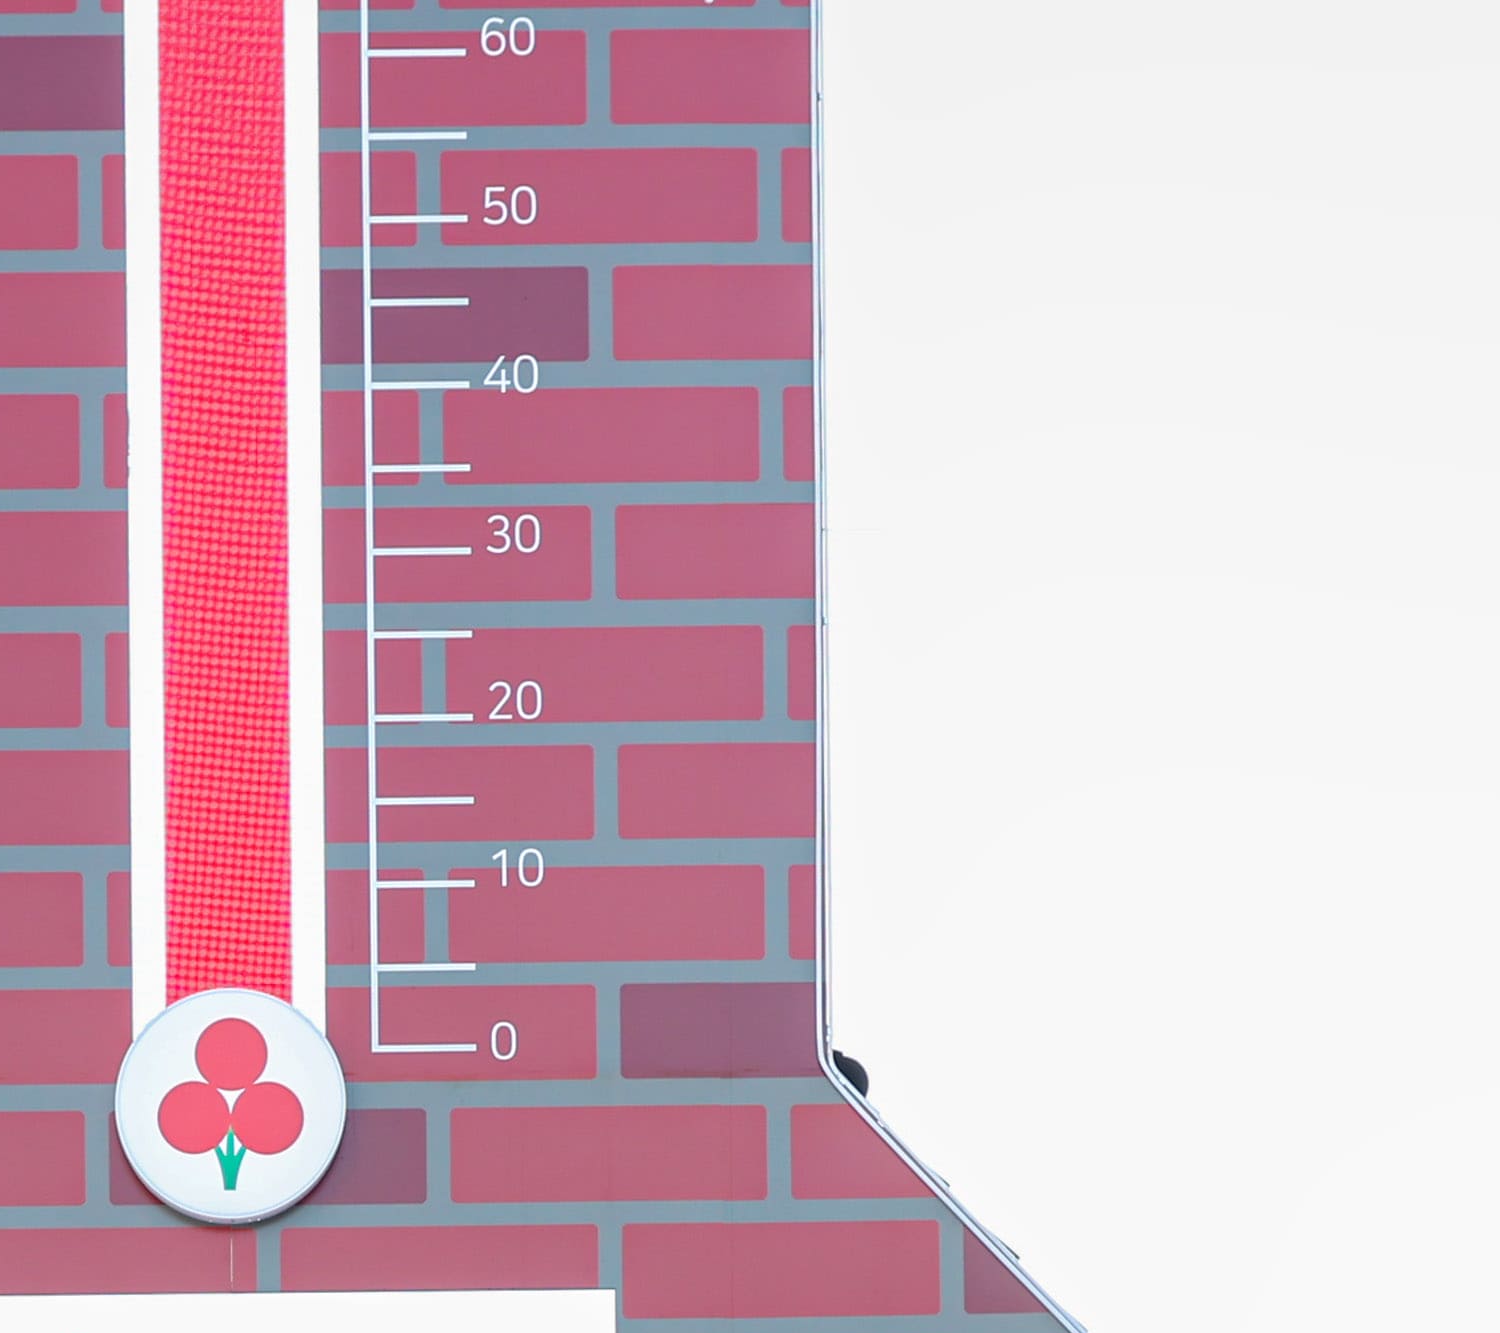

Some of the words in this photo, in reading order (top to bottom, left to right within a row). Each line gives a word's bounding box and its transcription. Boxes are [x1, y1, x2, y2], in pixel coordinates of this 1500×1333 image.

[480, 16, 536, 57] 60
[482, 185, 538, 226] 50
[483, 355, 539, 394] 40
[486, 513, 541, 554] 30
[488, 680, 543, 721] 20
[491, 848, 545, 888] 10
[490, 1021, 517, 1061] 0
